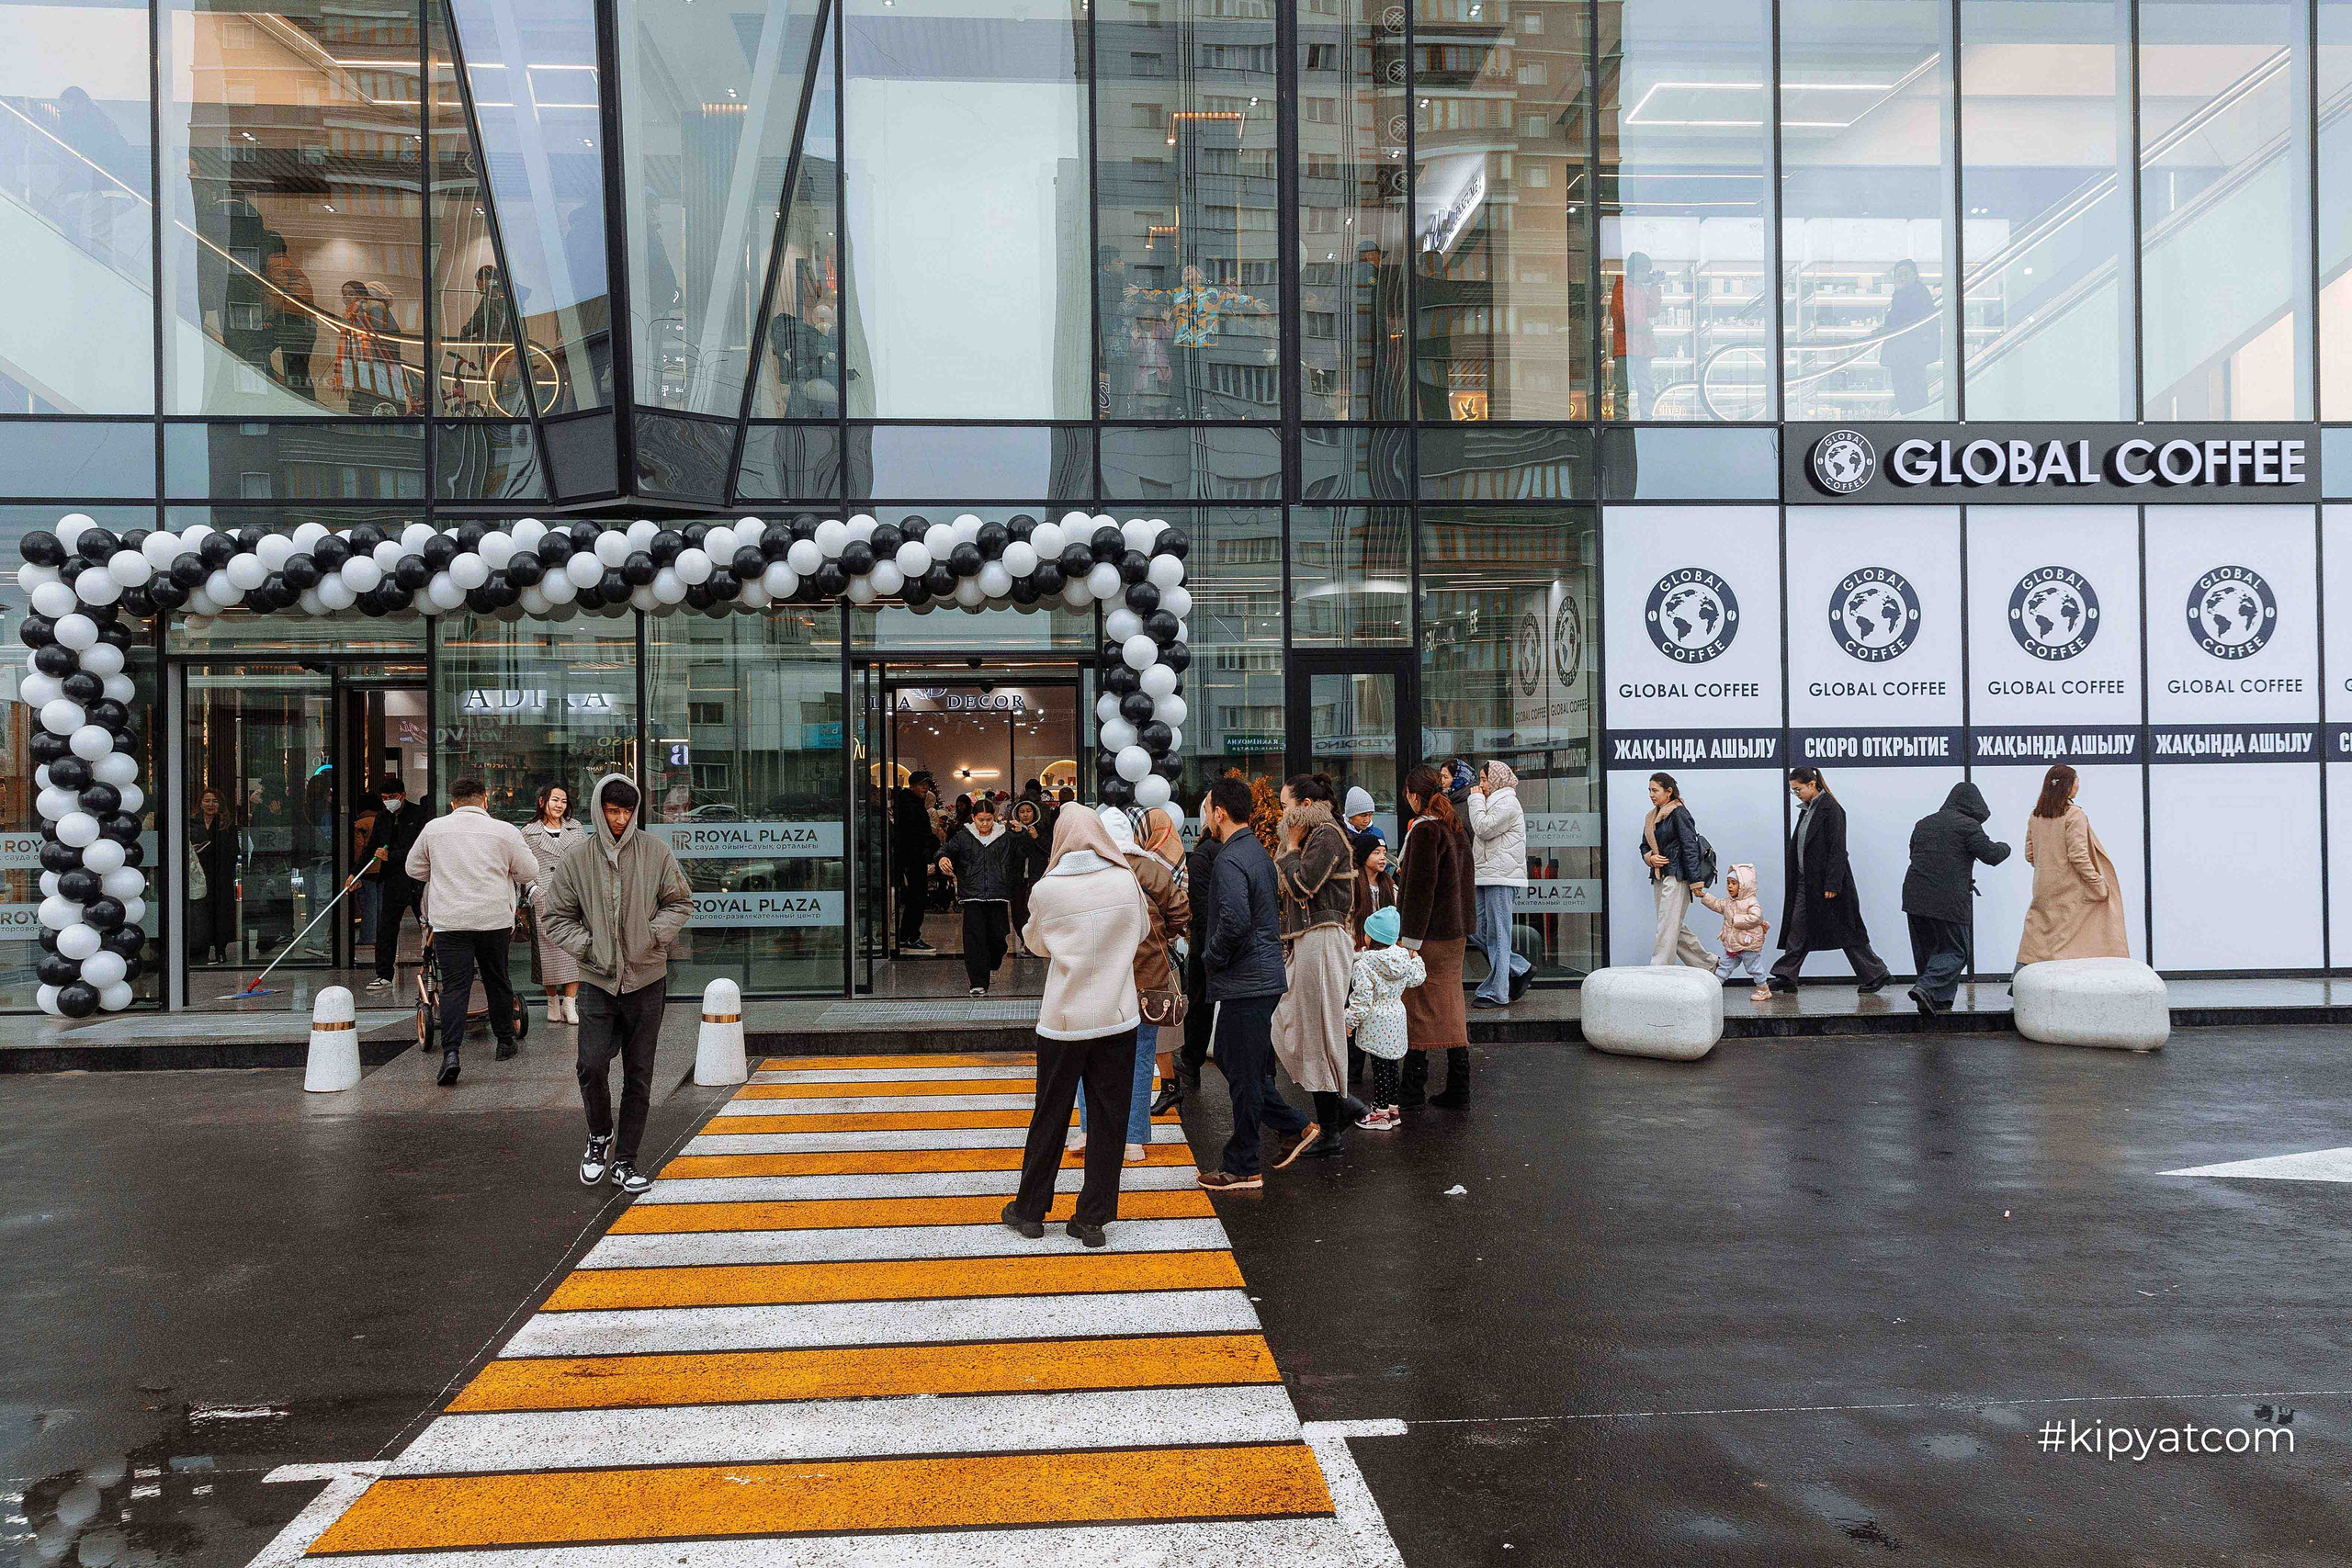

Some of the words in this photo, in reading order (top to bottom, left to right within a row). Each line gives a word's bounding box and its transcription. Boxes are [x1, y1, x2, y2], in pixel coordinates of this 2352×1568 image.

[1825, 433, 1865, 447] GLOBAL
[1893, 439, 2101, 484] GLOBAL
[2115, 439, 2306, 484] COFFEE
[1826, 477, 1865, 491] COFFEE
[1660, 570, 1724, 592] GLOBAL
[1842, 570, 1906, 592] GLOBAL
[2022, 568, 2086, 591] GLOBAL
[2199, 568, 2264, 590] GLOBAL
[1661, 640, 1725, 662] COFFEE
[1845, 638, 1907, 660] COFFEE
[2024, 637, 2086, 660] COFFEE
[2202, 636, 2265, 658] COFFEE
[1619, 683, 1689, 698] GLOBAL
[1694, 682, 1758, 697] COFFEE
[1809, 682, 1877, 696] GLOBAL
[1883, 682, 1946, 696] COFFEE
[1987, 681, 2055, 694] GLOBAL
[2062, 680, 2124, 694] COFFEE
[2167, 680, 2234, 694] GLOBAL
[2240, 679, 2302, 693] COFFEE
[464, 689, 610, 708] ADIA
[947, 694, 1025, 709] DECOR
[1551, 702, 1569, 716] GLOBAL
[1569, 698, 1588, 713] COFFEE
[1614, 739, 1706, 762] ЖАҚЫНДА
[1710, 738, 1777, 759] АШЫЛУ
[1804, 737, 1858, 758] СКОРО
[1862, 736, 1949, 757] ОТКРЫТИЕ
[1977, 736, 2067, 759] ЖАҚЫНДА
[2070, 734, 2135, 755] АШЫЛУ
[2155, 734, 2245, 757] ЖАҚЫНДА
[2248, 732, 2312, 753] АШЫЛУ
[1526, 820, 1581, 832] PLAZA
[695, 829, 753, 843] ROYAL
[759, 829, 818, 841] PLAZA
[5, 840, 43, 852] ROY
[1527, 886, 1586, 898] PLAZA
[692, 899, 752, 913] ROYAL
[759, 898, 821, 911] PLAZA
[0, 910, 42, 924] ROY
